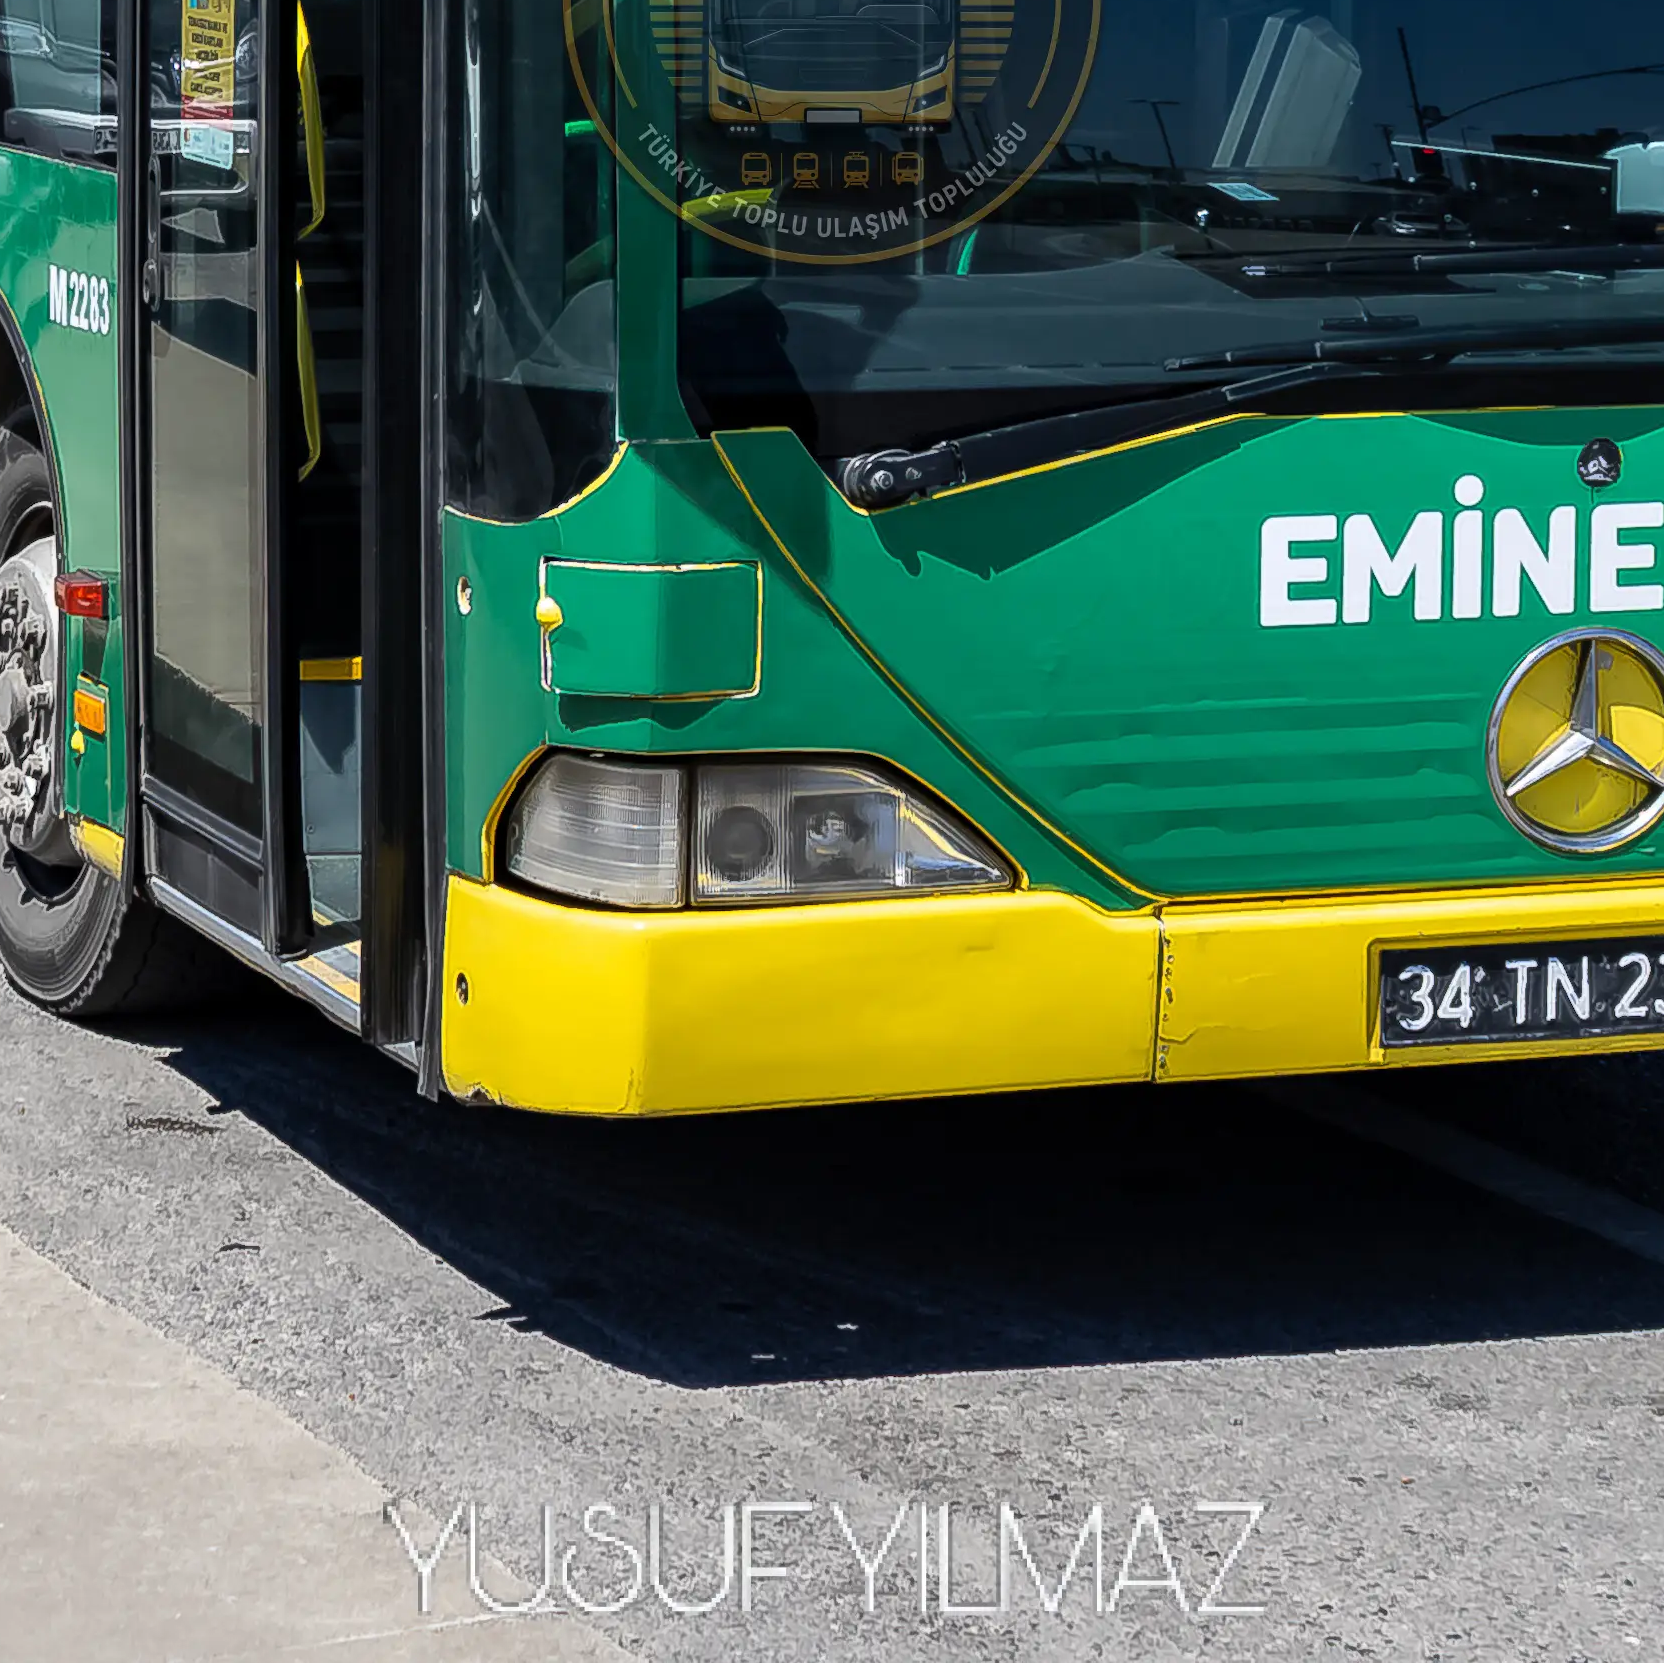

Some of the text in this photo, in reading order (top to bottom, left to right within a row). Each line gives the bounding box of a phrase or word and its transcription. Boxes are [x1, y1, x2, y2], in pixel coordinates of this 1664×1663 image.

[48, 263, 110, 336] M2283
[1396, 963, 1477, 1032] 34
[1506, 955, 1590, 1026] TN
